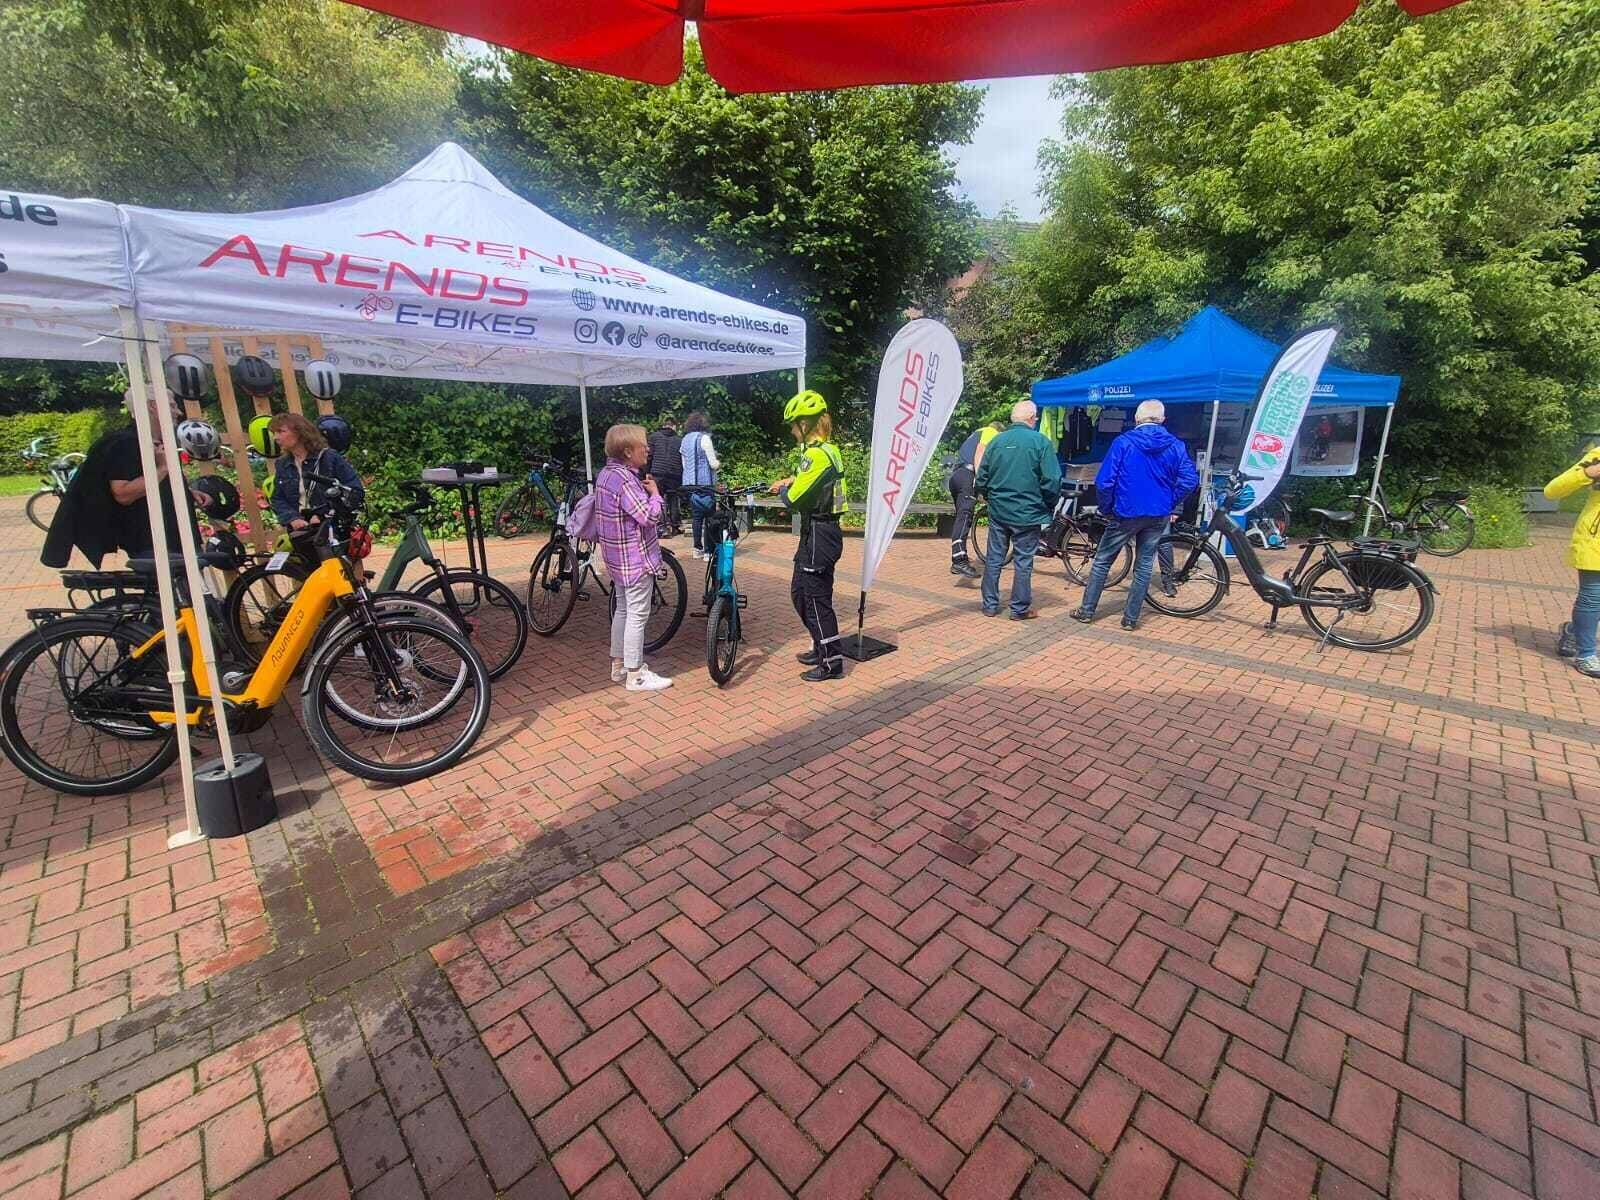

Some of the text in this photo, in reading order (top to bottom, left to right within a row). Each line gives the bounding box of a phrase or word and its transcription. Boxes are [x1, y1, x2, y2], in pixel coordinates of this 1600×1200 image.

[198, 234, 529, 307] ARENDS
[355, 229, 647, 283] ARENDS
[539, 265, 668, 294] E-BIKES
[395, 303, 538, 335] E-BIKES
[602, 296, 789, 335] www.arends-ebikes.de
[916, 352, 940, 438] E-BIKES
[1104, 385, 1131, 394] POLIZEI
[882, 348, 924, 515] ARENDS
[271, 609, 305, 667] ADVANCED
